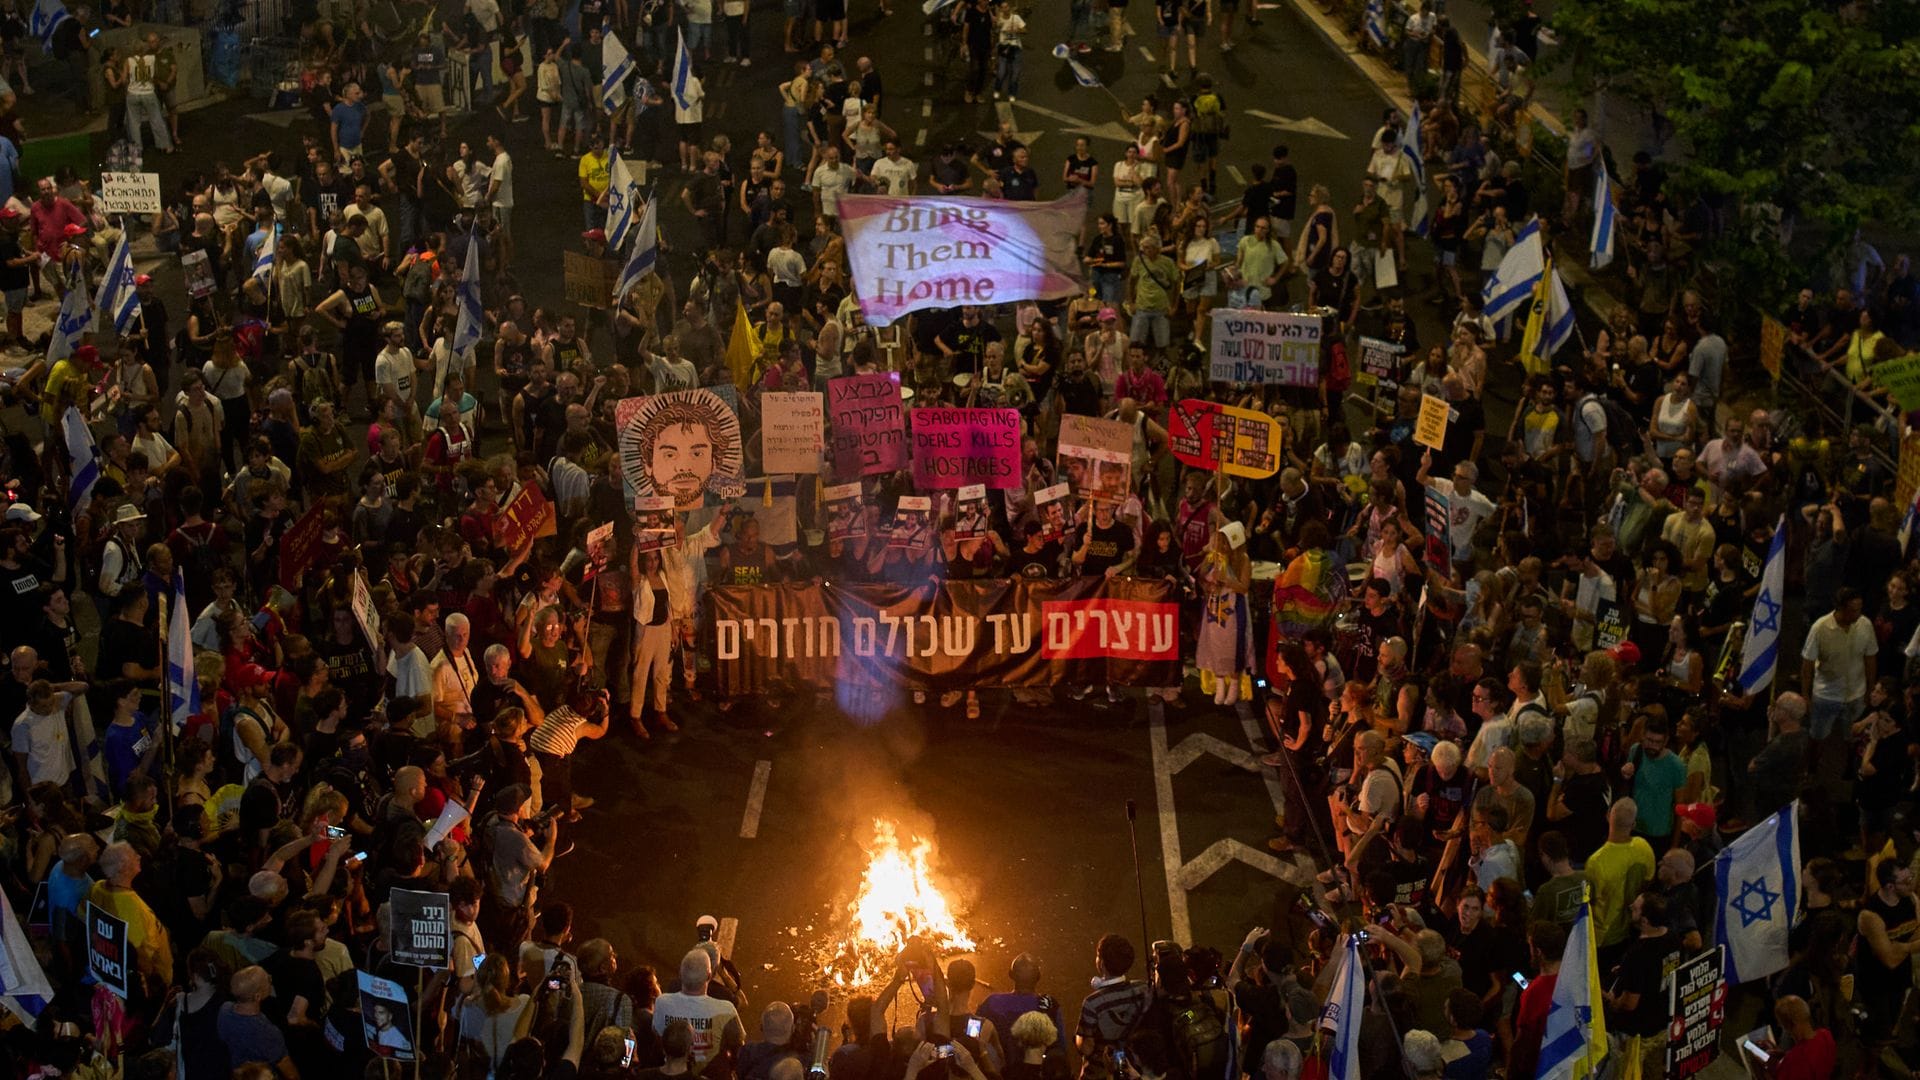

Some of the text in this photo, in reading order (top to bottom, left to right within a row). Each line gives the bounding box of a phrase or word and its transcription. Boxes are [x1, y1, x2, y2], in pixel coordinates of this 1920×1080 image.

[882, 204, 990, 232] Bring
[878, 240, 992, 270] Them
[875, 277, 995, 306] Home
[1225, 319, 1319, 339] מי האיש החפץ
[1267, 343, 1281, 360] סור
[1234, 361, 1264, 382] שלום
[835, 381, 894, 403] מבצע
[839, 404, 900, 427] הפקרת
[916, 411, 1017, 428] SABOTAGING
[918, 431, 1015, 448] DEALS KILLS
[924, 456, 1012, 477] HOSTAGES
[720, 486, 742, 498] אלון
[716, 610, 1174, 660] עוצרים עד שכולם חוזרים
[422, 906, 445, 920] ביבי
[97, 918, 114, 940] עם
[411, 919, 446, 935] מנותק
[412, 934, 446, 949] מהעם
[1690, 960, 1710, 982] הלחץ
[690, 1018, 713, 1030] THEM
